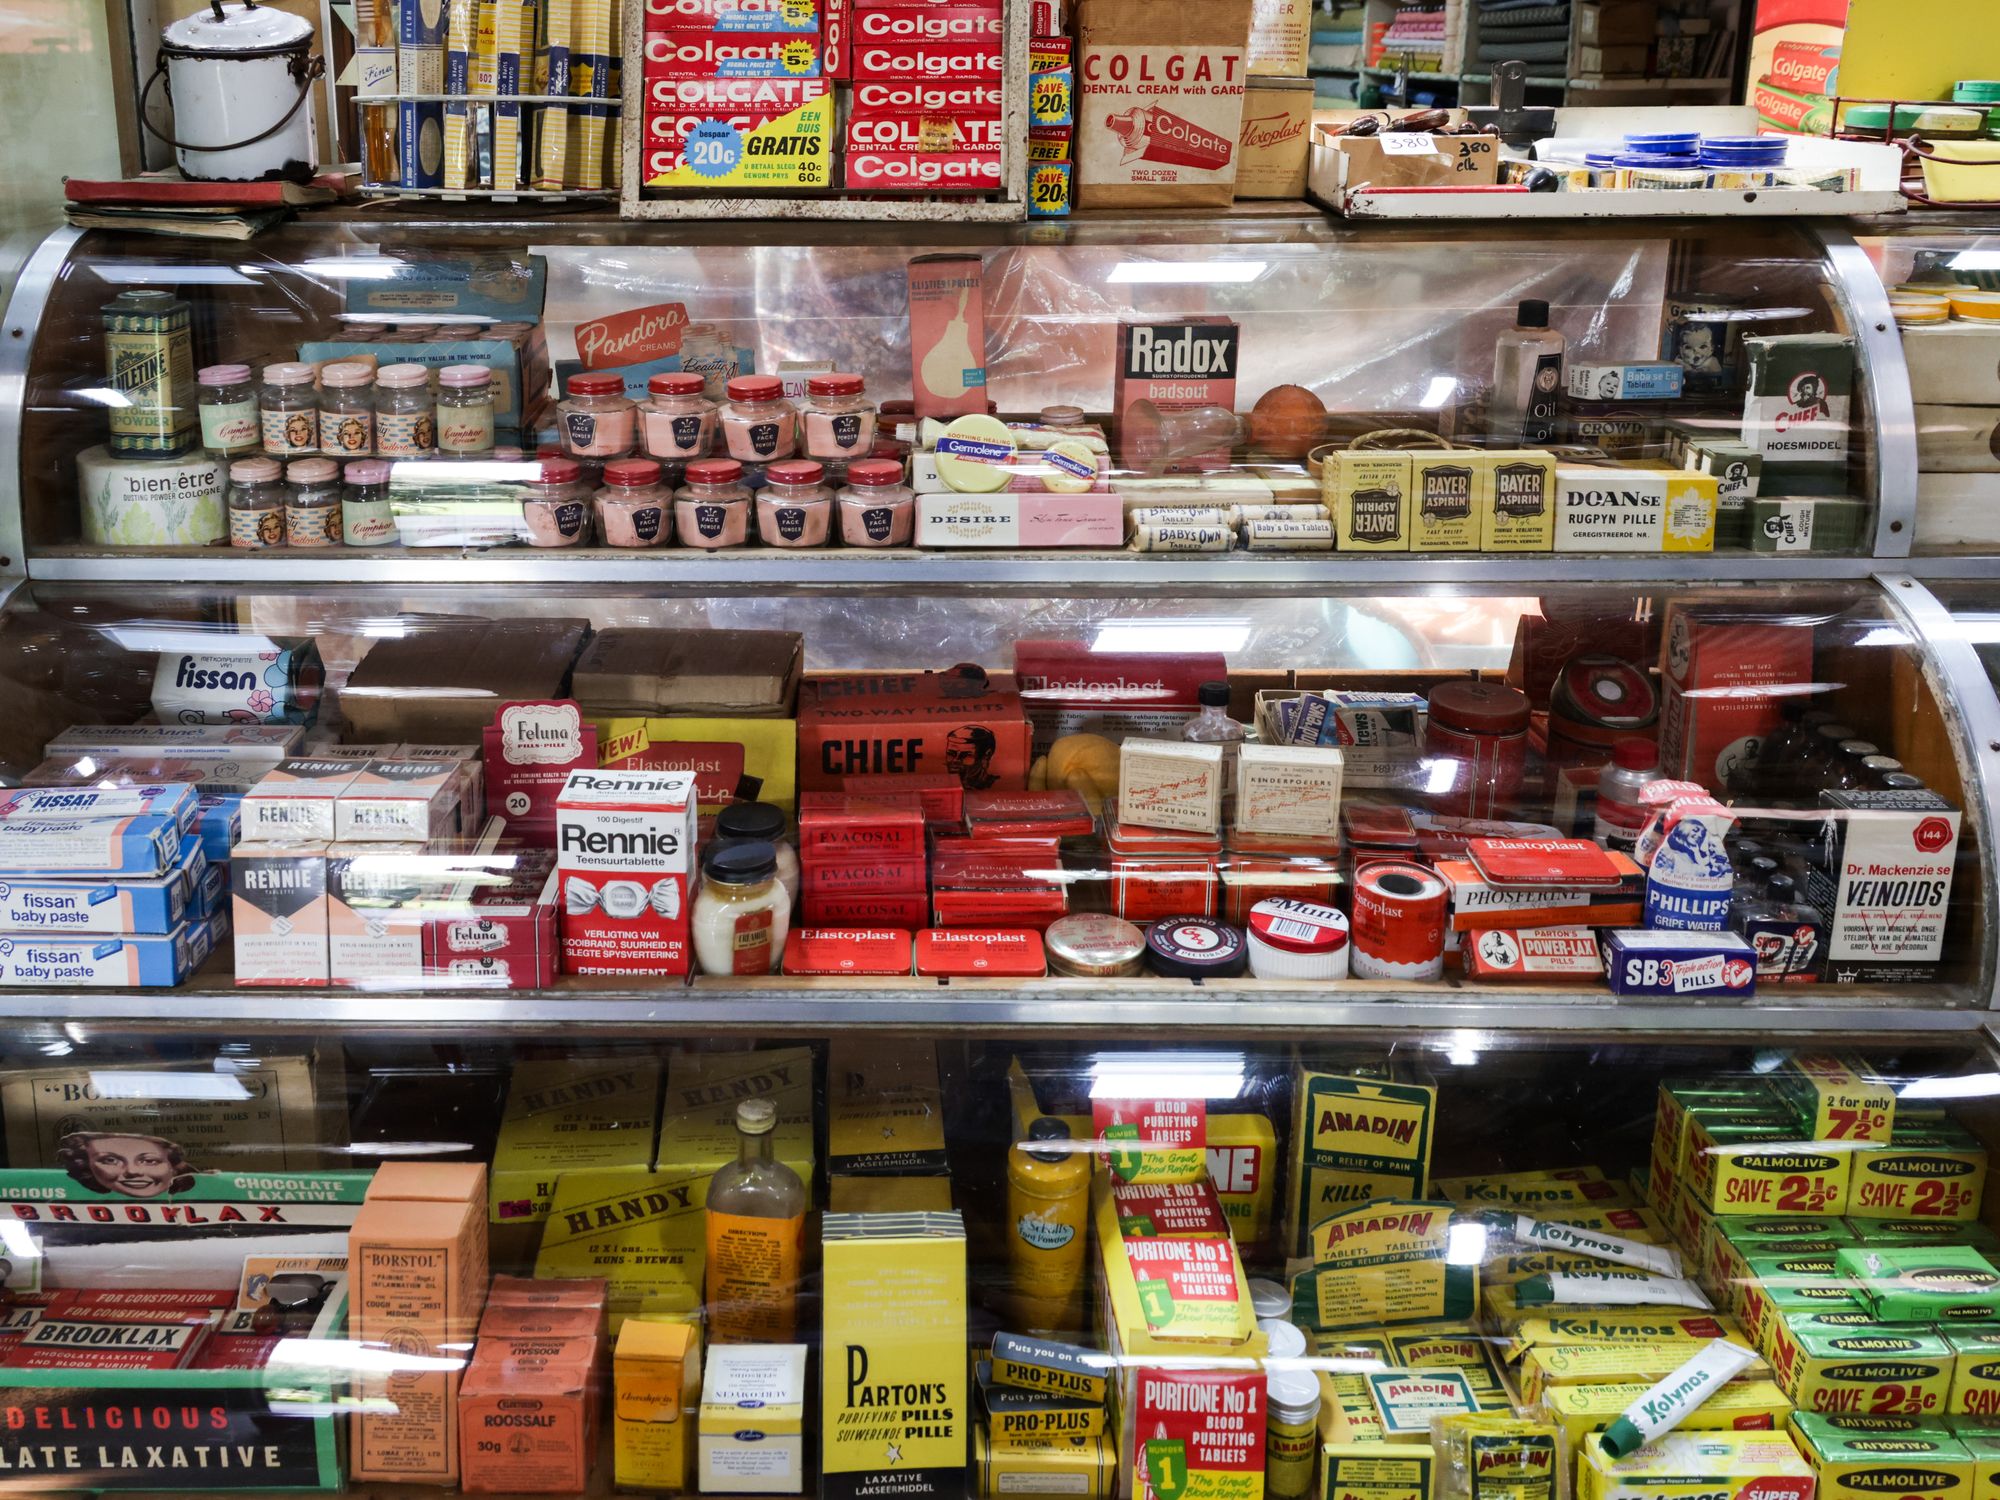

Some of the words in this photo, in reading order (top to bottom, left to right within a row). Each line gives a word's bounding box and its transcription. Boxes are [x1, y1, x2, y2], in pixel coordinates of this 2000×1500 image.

[1031, 42, 1066, 50] COLGATE
[786, 56, 809, 66] 5c
[863, 50, 1003, 75] Colgate
[1773, 55, 1827, 83] Colgate
[652, 80, 824, 103] COLGATE
[1037, 83, 1063, 94] SAVE
[1084, 84, 1137, 95] DENTAL
[1141, 84, 1179, 95] CREAM
[1183, 84, 1207, 95] with
[859, 85, 1003, 110] Colgate
[800, 111, 821, 122] EEN
[698, 130, 730, 139] bespaar
[796, 123, 821, 134] BUIS
[1031, 129, 1066, 137] COLGATE
[747, 135, 821, 156] GRATIS
[851, 143, 896, 151] DENTAL
[693, 141, 735, 165] 20c
[1032, 147, 1061, 159] FREE
[797, 161, 822, 172] 40c
[854, 155, 1001, 182] Colgate
[797, 172, 822, 182] 60c
[1037, 173, 1063, 184] SAVE
[585, 309, 686, 368] Pandora
[640, 341, 676, 352] CREAMS
[1131, 325, 1230, 374] Radox
[1148, 381, 1209, 400] badsout
[1534, 403, 1556, 418] Oil
[1767, 440, 1841, 451] HOESMIDDEL
[1426, 476, 1466, 494] BAYER
[1500, 474, 1540, 494] BAYER
[150, 492, 177, 500] POWDER
[178, 486, 222, 498] COLOGNE
[1498, 495, 1540, 505] ASPIRIN
[1356, 501, 1396, 511] ASPIRIN
[1425, 497, 1467, 507] ASPIRIN
[930, 515, 1012, 524] DESIRE
[1567, 513, 1616, 525] RUGPYN
[1622, 513, 1657, 525] PILLE
[175, 656, 257, 690] fissan
[819, 707, 916, 718] TWO-WAY
[925, 703, 1005, 714] TABLETS
[518, 721, 569, 741] Feluna
[822, 738, 923, 775] CHIEF
[288, 761, 353, 772] RENNIE
[378, 764, 443, 774] RENNIE
[1250, 776, 1333, 786] KINDERPOEIERS
[510, 797, 527, 811] 20
[596, 815, 610, 823] 100
[611, 816, 643, 825] Digestif
[561, 823, 678, 856] Rennie
[1922, 829, 1941, 840] 144
[1484, 839, 1588, 853] Elastoplast
[1847, 864, 1867, 875] Dr.
[1868, 864, 1934, 875] Mackenzie
[1936, 866, 1950, 876] se
[244, 869, 312, 890] RENNIE
[23, 892, 75, 909] fissan
[1845, 880, 1945, 907] VEINOIDS
[1649, 889, 1730, 916] PHILLIPS
[11, 909, 48, 924] baby
[49, 911, 90, 924] paste
[1278, 898, 1343, 923] Mum
[584, 929, 639, 940] VERLIGTING
[641, 930, 659, 940] VAN
[800, 929, 897, 943] Elastoplast
[931, 931, 1027, 945] Elastoplast
[1534, 929, 1578, 938] PARTON'S
[620, 939, 666, 950] SUURHEID
[668, 941, 682, 951] EN
[1525, 938, 1595, 957] POWER-LAX
[26, 948, 80, 964] fissan
[566, 948, 601, 958] SLEGTE
[602, 949, 679, 960] SPYSVERTERING
[1550, 957, 1575, 965] PILLS
[14, 965, 50, 979] baby
[52, 966, 95, 979] paste
[1626, 961, 1672, 987] SB3
[1681, 974, 1716, 989] PILLS
[1154, 1101, 1187, 1113] BLOOD
[1143, 1115, 1198, 1128] PURIFYING
[1317, 1110, 1419, 1145] ANADIN
[1151, 1130, 1191, 1142] TABLETS
[846, 1158, 927, 1169] LAKSEERMIDDEL
[858, 1152, 917, 1162] LAXATIVE
[1316, 1153, 1333, 1163] FOR
[1338, 1156, 1369, 1167] RELIEF
[1372, 1159, 1384, 1168] OF
[1389, 1161, 1411, 1171] PAIN
[1742, 1156, 1827, 1167] PALMOLIVE
[1878, 1161, 1964, 1173] PALMOLIVE
[233, 1177, 344, 1192] CHOCOLATE
[246, 1190, 339, 1202] LAXATIVE
[1321, 1183, 1373, 1203] KILLS
[1164, 1197, 1197, 1207] BLOOD
[564, 1185, 694, 1236] HANDY
[1155, 1207, 1212, 1217] PURIFYING
[1165, 1217, 1208, 1228] TABLETS
[1326, 1211, 1433, 1250] ANADIN
[1529, 1221, 1625, 1256] Kolynos
[1182, 1261, 1218, 1272] BLOOD
[1336, 1260, 1355, 1268] FOR
[1358, 1257, 1384, 1266] RELIEF
[1403, 1252, 1425, 1261] PAIN
[1173, 1272, 1233, 1285] PURIFYING
[1181, 1284, 1227, 1296] TABLETS
[96, 1293, 122, 1303] FOR
[126, 1293, 215, 1304] CONSTIPATION
[34, 1323, 180, 1346] BROOKLAX
[1008, 1341, 1032, 1353] Puts
[1034, 1348, 1055, 1359] you
[1058, 1351, 1072, 1361] on
[1836, 1339, 1914, 1349] PALMOLIVE
[33, 1351, 98, 1361] CHOCOLATE
[99, 1352, 154, 1361] LAXATIVE
[1408, 1344, 1474, 1362] ANADIN
[1005, 1362, 1093, 1394] PRO-PLUS
[1833, 1366, 1926, 1377] PALMOLIVE
[1388, 1383, 1456, 1399] ANADIN
[7, 1406, 229, 1430] DELICIOUS
[484, 1414, 556, 1428] ROOSSALF
[837, 1409, 898, 1425] PURIFYING
[901, 1407, 954, 1422] PILLS
[1003, 1412, 1091, 1432] PRO-PLUS
[1206, 1415, 1245, 1430] BLOOD
[836, 1427, 902, 1442] SUIWERENDE
[905, 1425, 954, 1439] PILLE
[1192, 1431, 1256, 1447] PURIFYING
[1148, 1445, 1184, 1455] NUMBER
[1199, 1448, 1247, 1464] TABLETS
[865, 1473, 922, 1484] LAXATIVE
[1850, 1474, 1947, 1487] PALMOLIVE
[855, 1482, 935, 1496] LAKSEERMIDDEL
